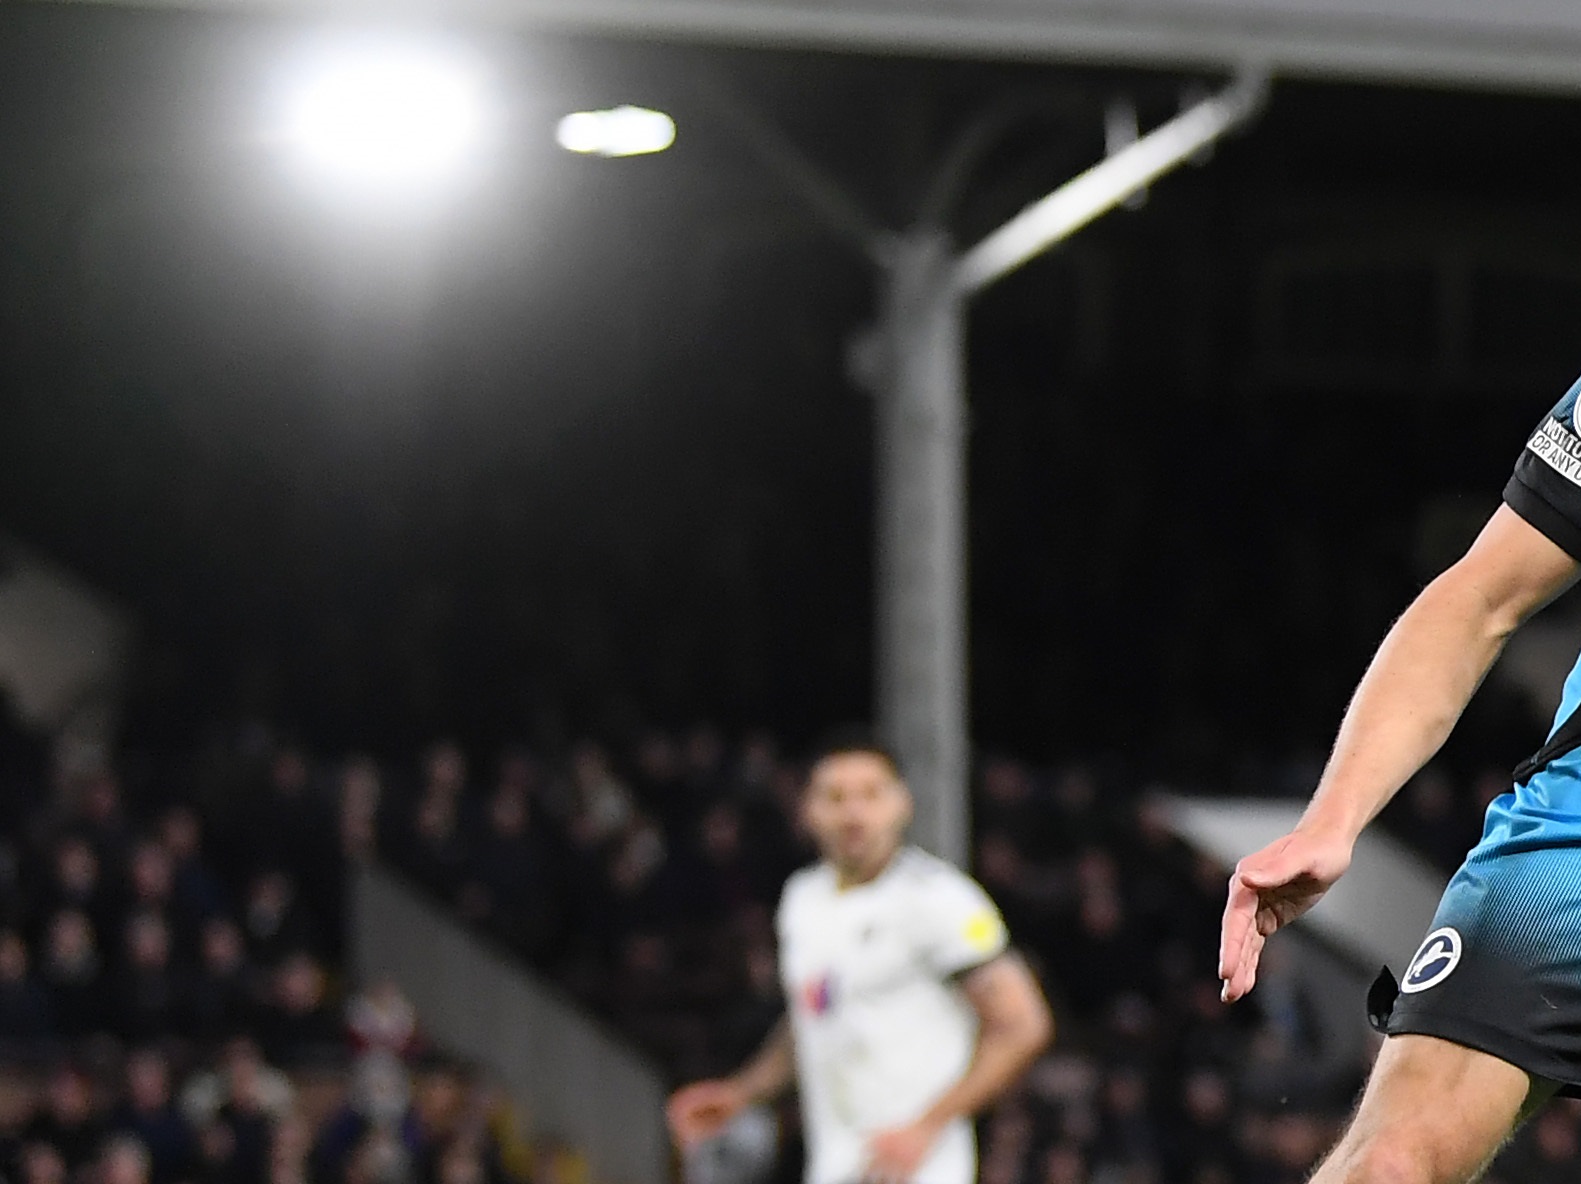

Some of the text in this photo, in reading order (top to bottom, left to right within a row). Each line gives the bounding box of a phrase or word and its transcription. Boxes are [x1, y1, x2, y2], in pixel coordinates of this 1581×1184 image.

[1543, 416, 1568, 448] NOT
[1532, 435, 1551, 454] OR
[1547, 448, 1576, 473] ANY
